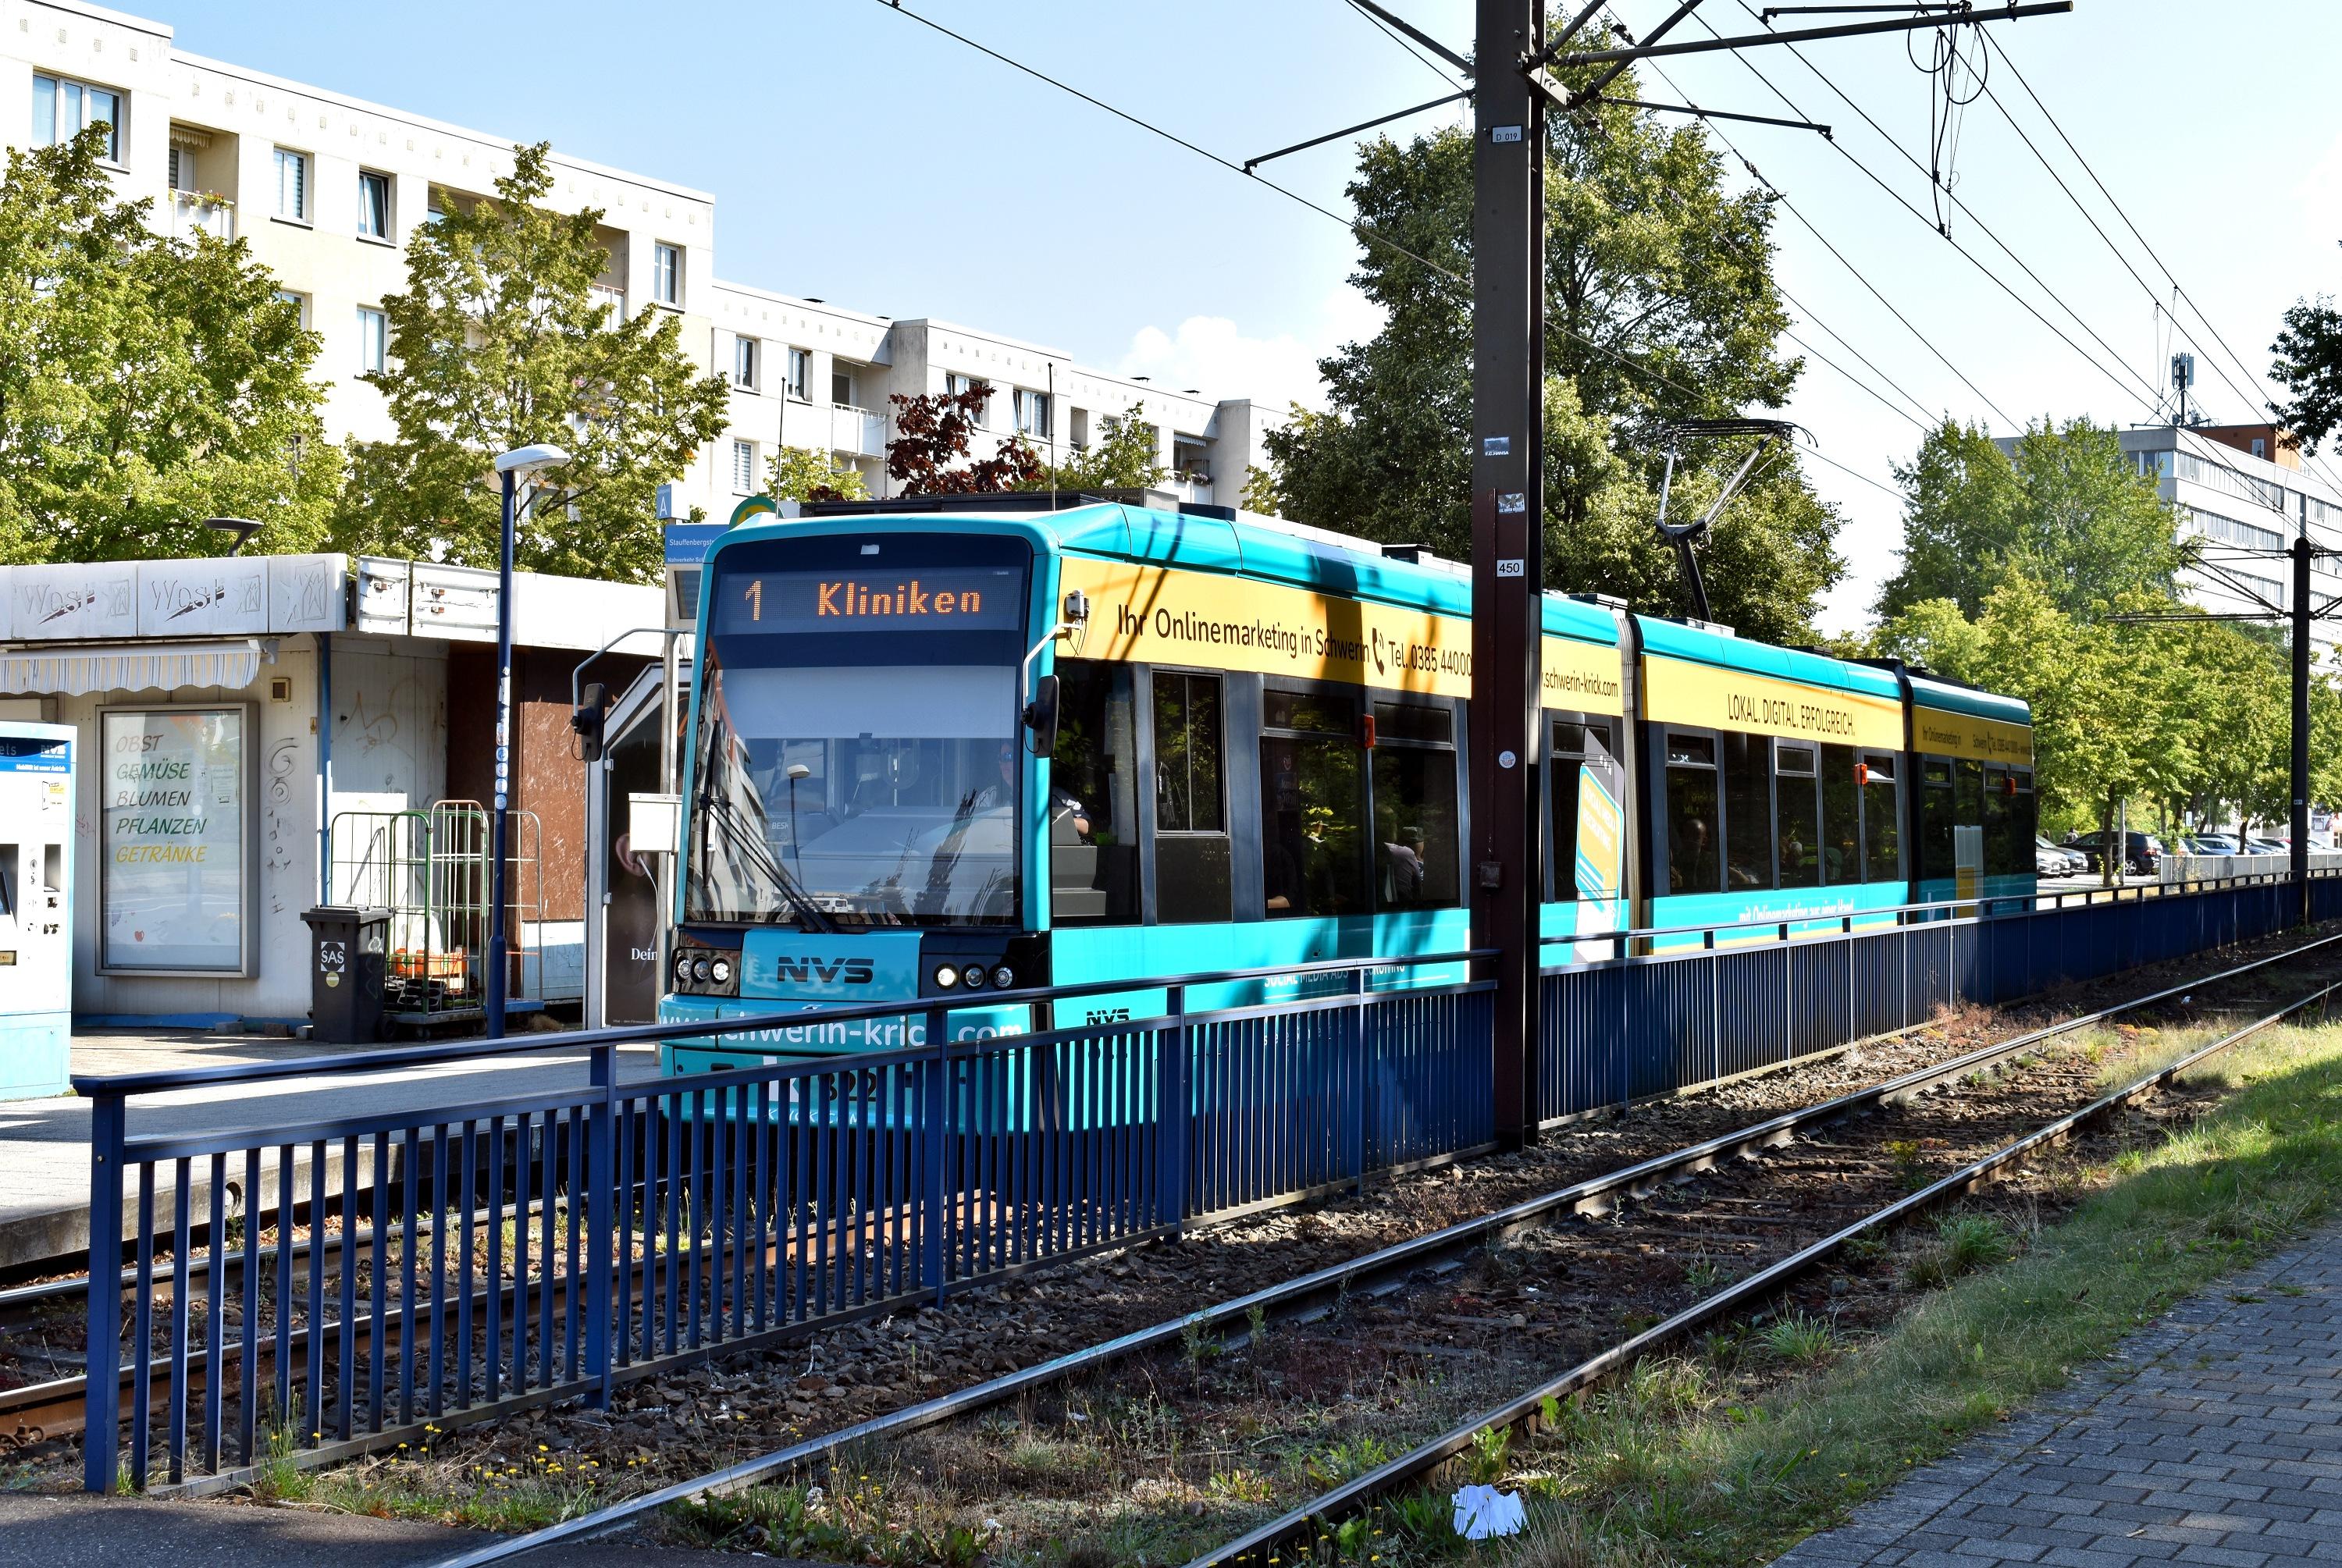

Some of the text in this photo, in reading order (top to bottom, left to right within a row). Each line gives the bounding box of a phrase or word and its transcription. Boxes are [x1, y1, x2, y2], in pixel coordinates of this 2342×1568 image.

[1504, 132, 1518, 140] 019
[659, 496, 668, 517] A
[1498, 562, 1520, 574] 450
[746, 580, 981, 620] 1 Kliniken
[1117, 603, 1147, 636] Ihr
[1155, 607, 1297, 660] Onlinemarketing
[1301, 625, 1312, 655] in
[1315, 628, 1370, 663] Schwerin
[1388, 641, 1408, 669] Tel.
[1411, 644, 1437, 673] 0385
[1542, 667, 1618, 698] .schwerin-krick.com
[1728, 693, 1856, 737] LOKAL. DIGITAL. ERFOLGREICH.
[116, 734, 165, 753] OBST
[116, 758, 190, 781] GEMÜSE
[116, 790, 192, 807] BLUMEN
[116, 818, 208, 835] PFLANZEN
[116, 841, 208, 863] GETRÄNKE
[321, 950, 344, 964] SAS
[631, 948, 657, 961] Dein
[777, 956, 874, 983] NVS
[1086, 1008, 1130, 1026] NVS
